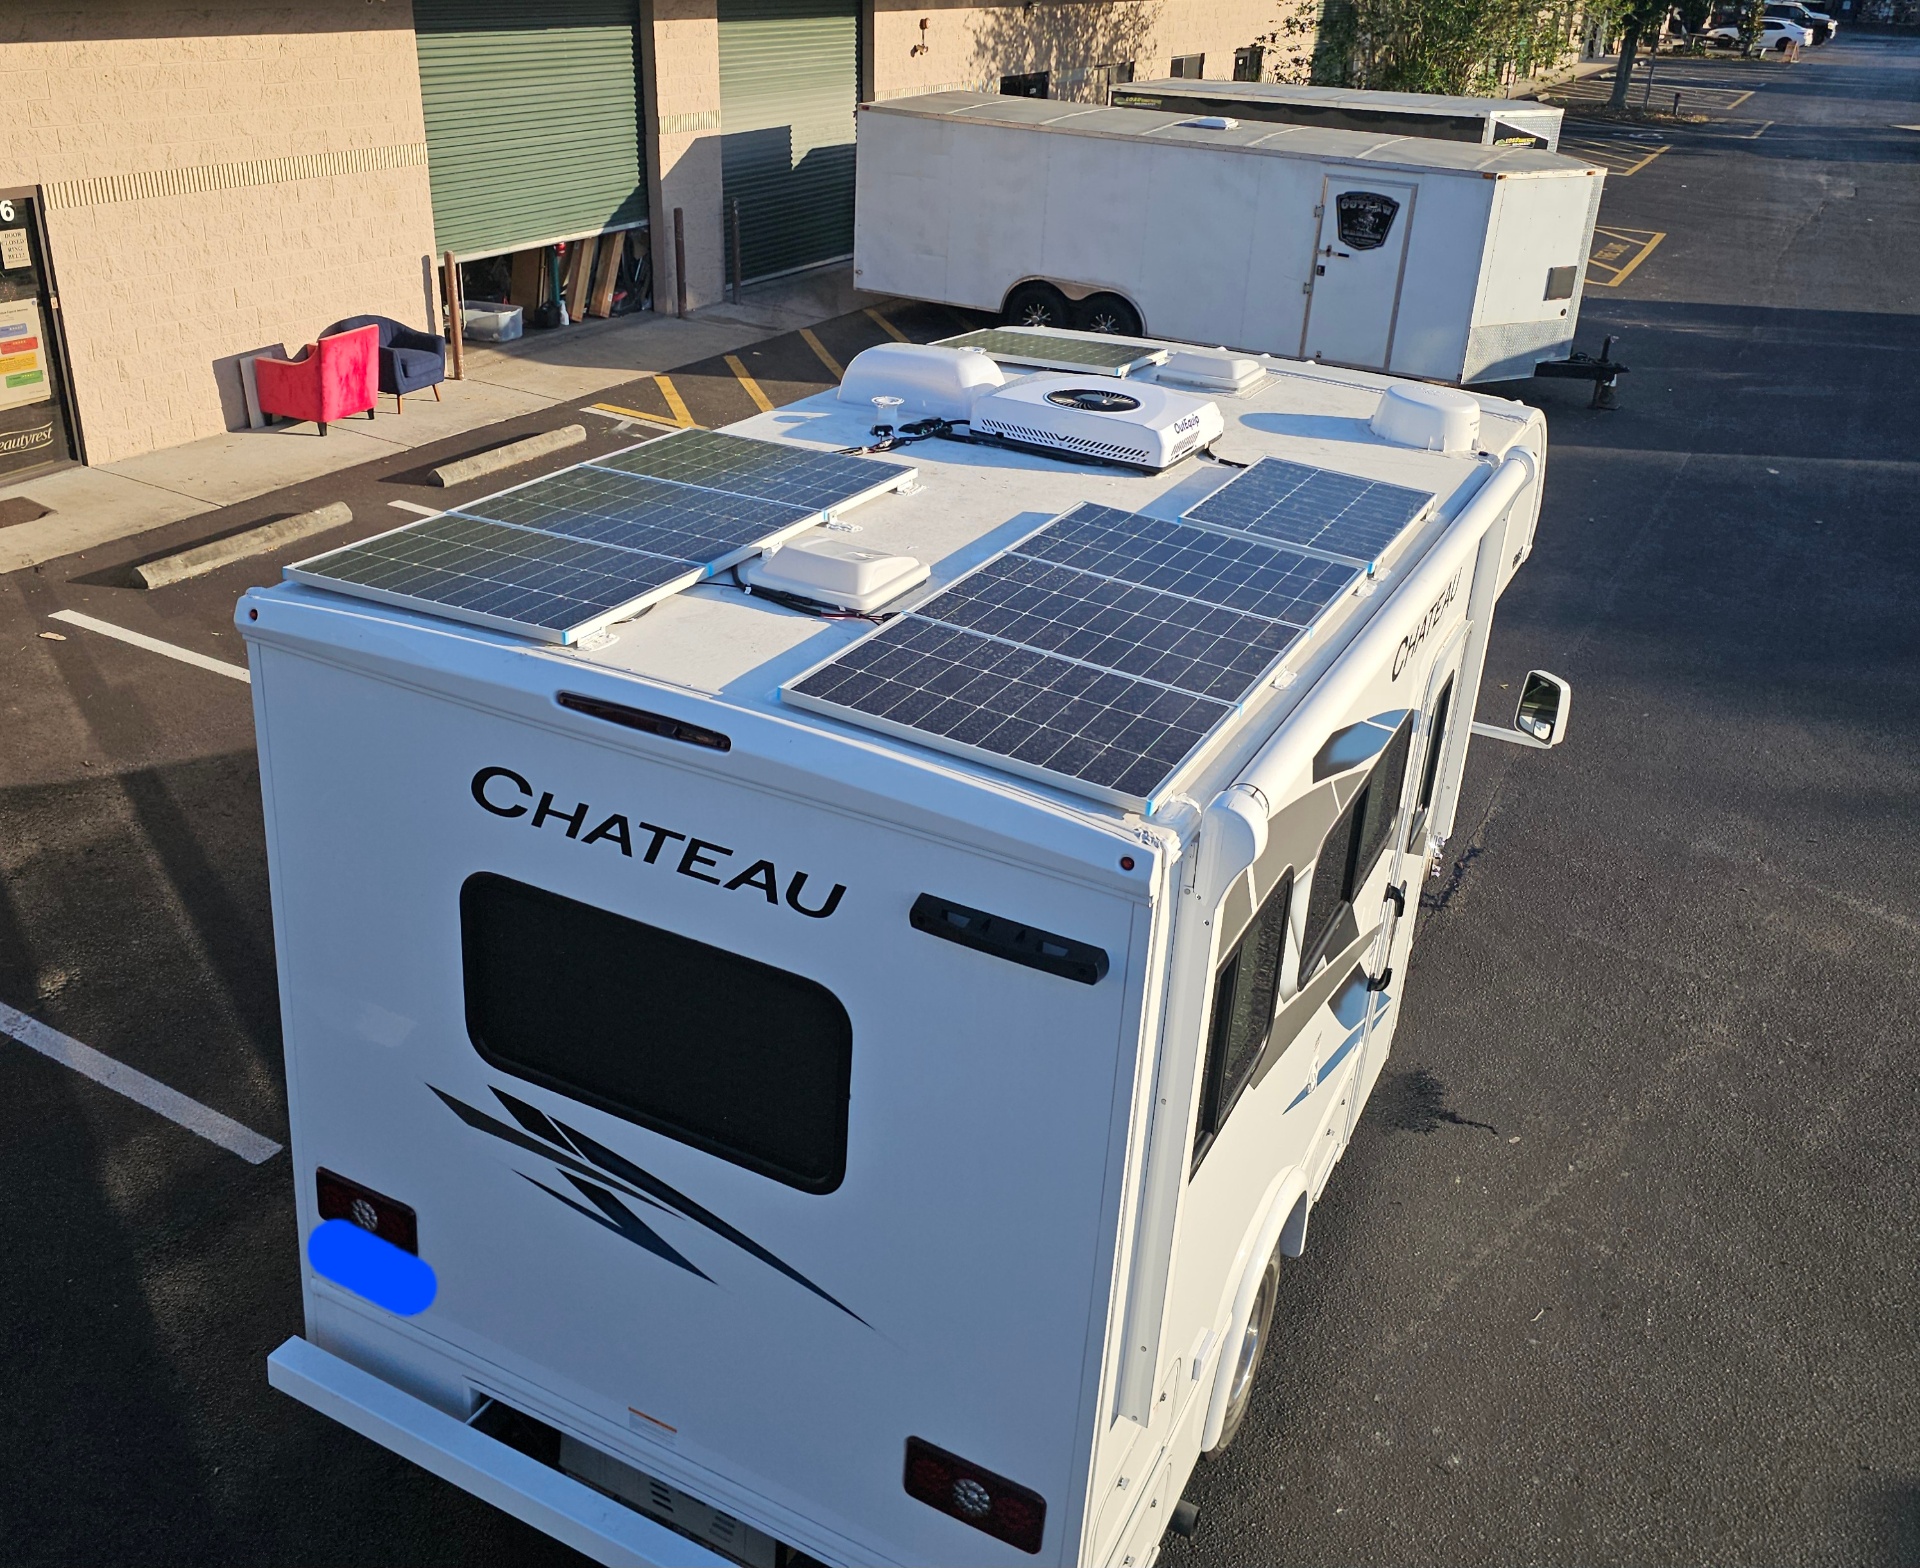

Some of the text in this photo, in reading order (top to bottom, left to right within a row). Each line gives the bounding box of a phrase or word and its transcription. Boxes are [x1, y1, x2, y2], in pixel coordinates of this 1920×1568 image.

[0, 200, 14, 221] 6
[1173, 413, 1200, 434] OutEquip
[1391, 566, 1462, 682] CHATEAU
[471, 766, 847, 918] CHATEAU
